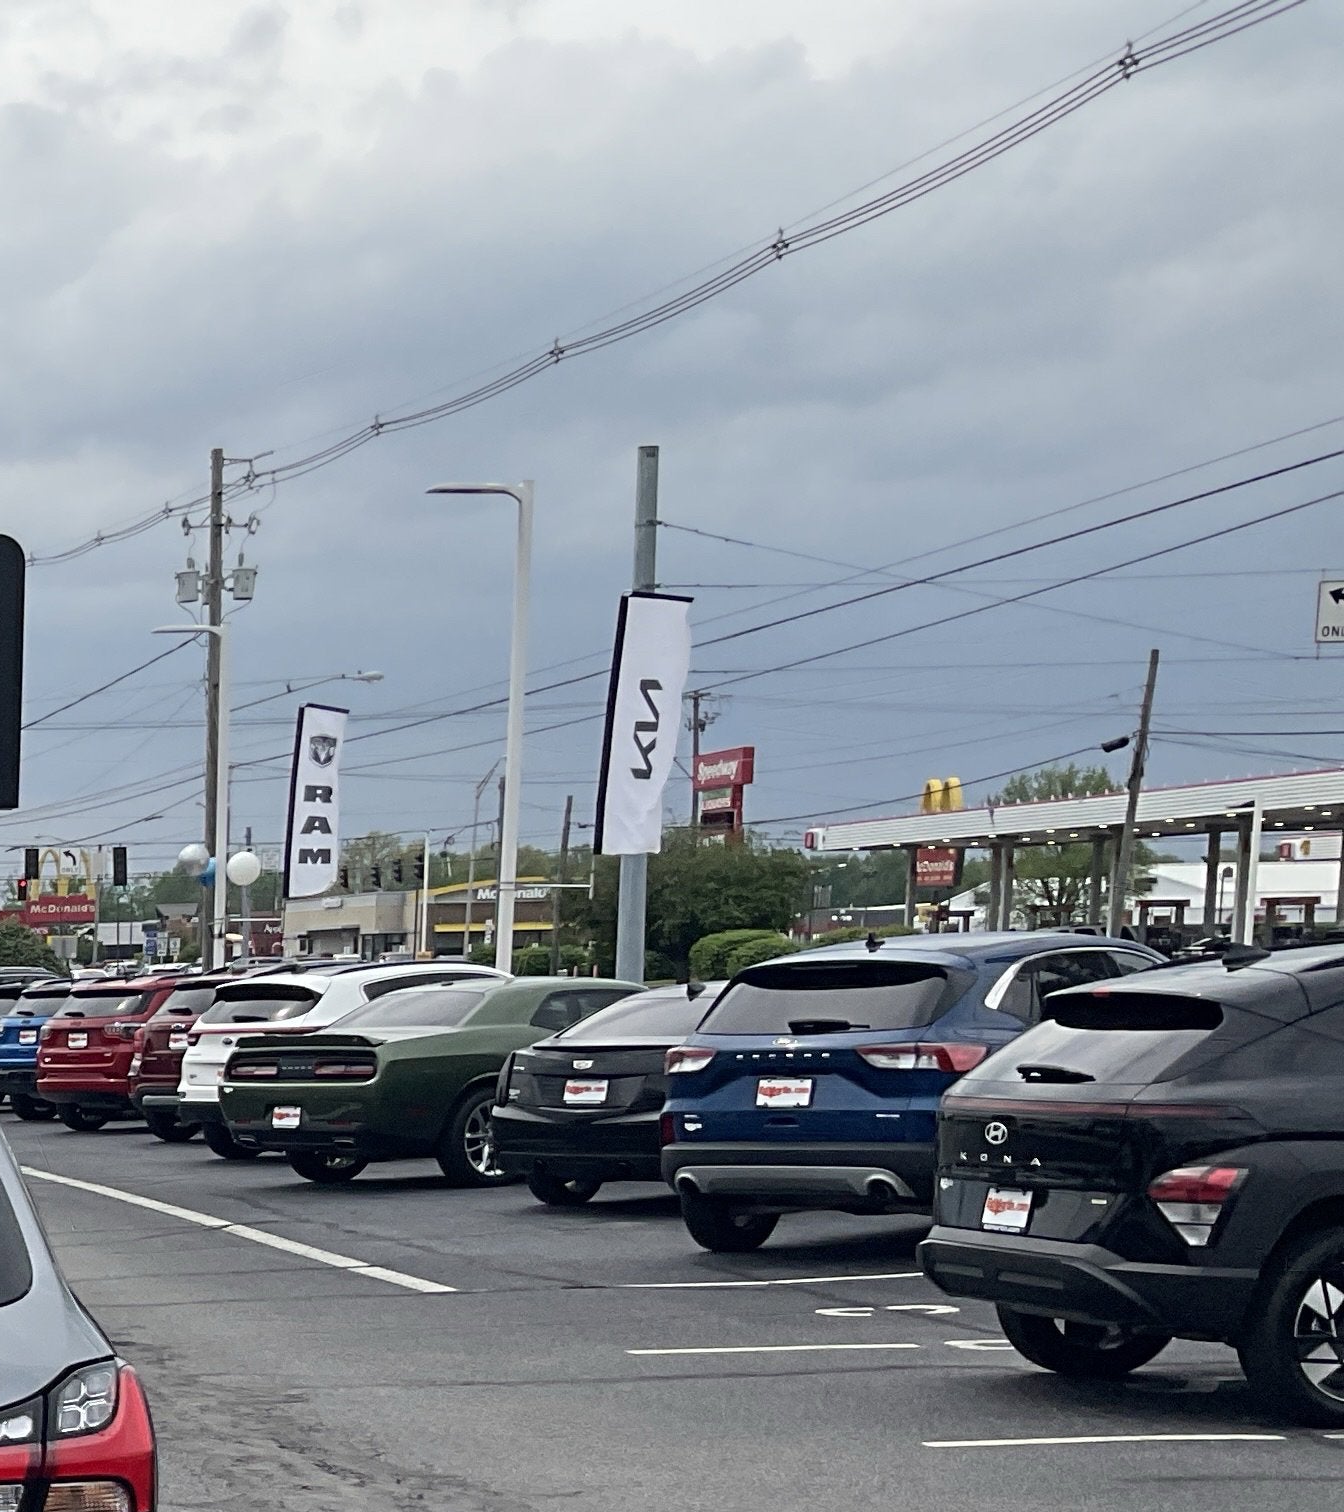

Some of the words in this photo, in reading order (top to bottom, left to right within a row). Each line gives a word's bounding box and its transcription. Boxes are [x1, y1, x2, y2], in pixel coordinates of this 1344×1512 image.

[697, 760, 739, 784] Speedway
[298, 785, 333, 864] RAM
[30, 904, 96, 914] McDonald's
[959, 1151, 1042, 1167] KONA
